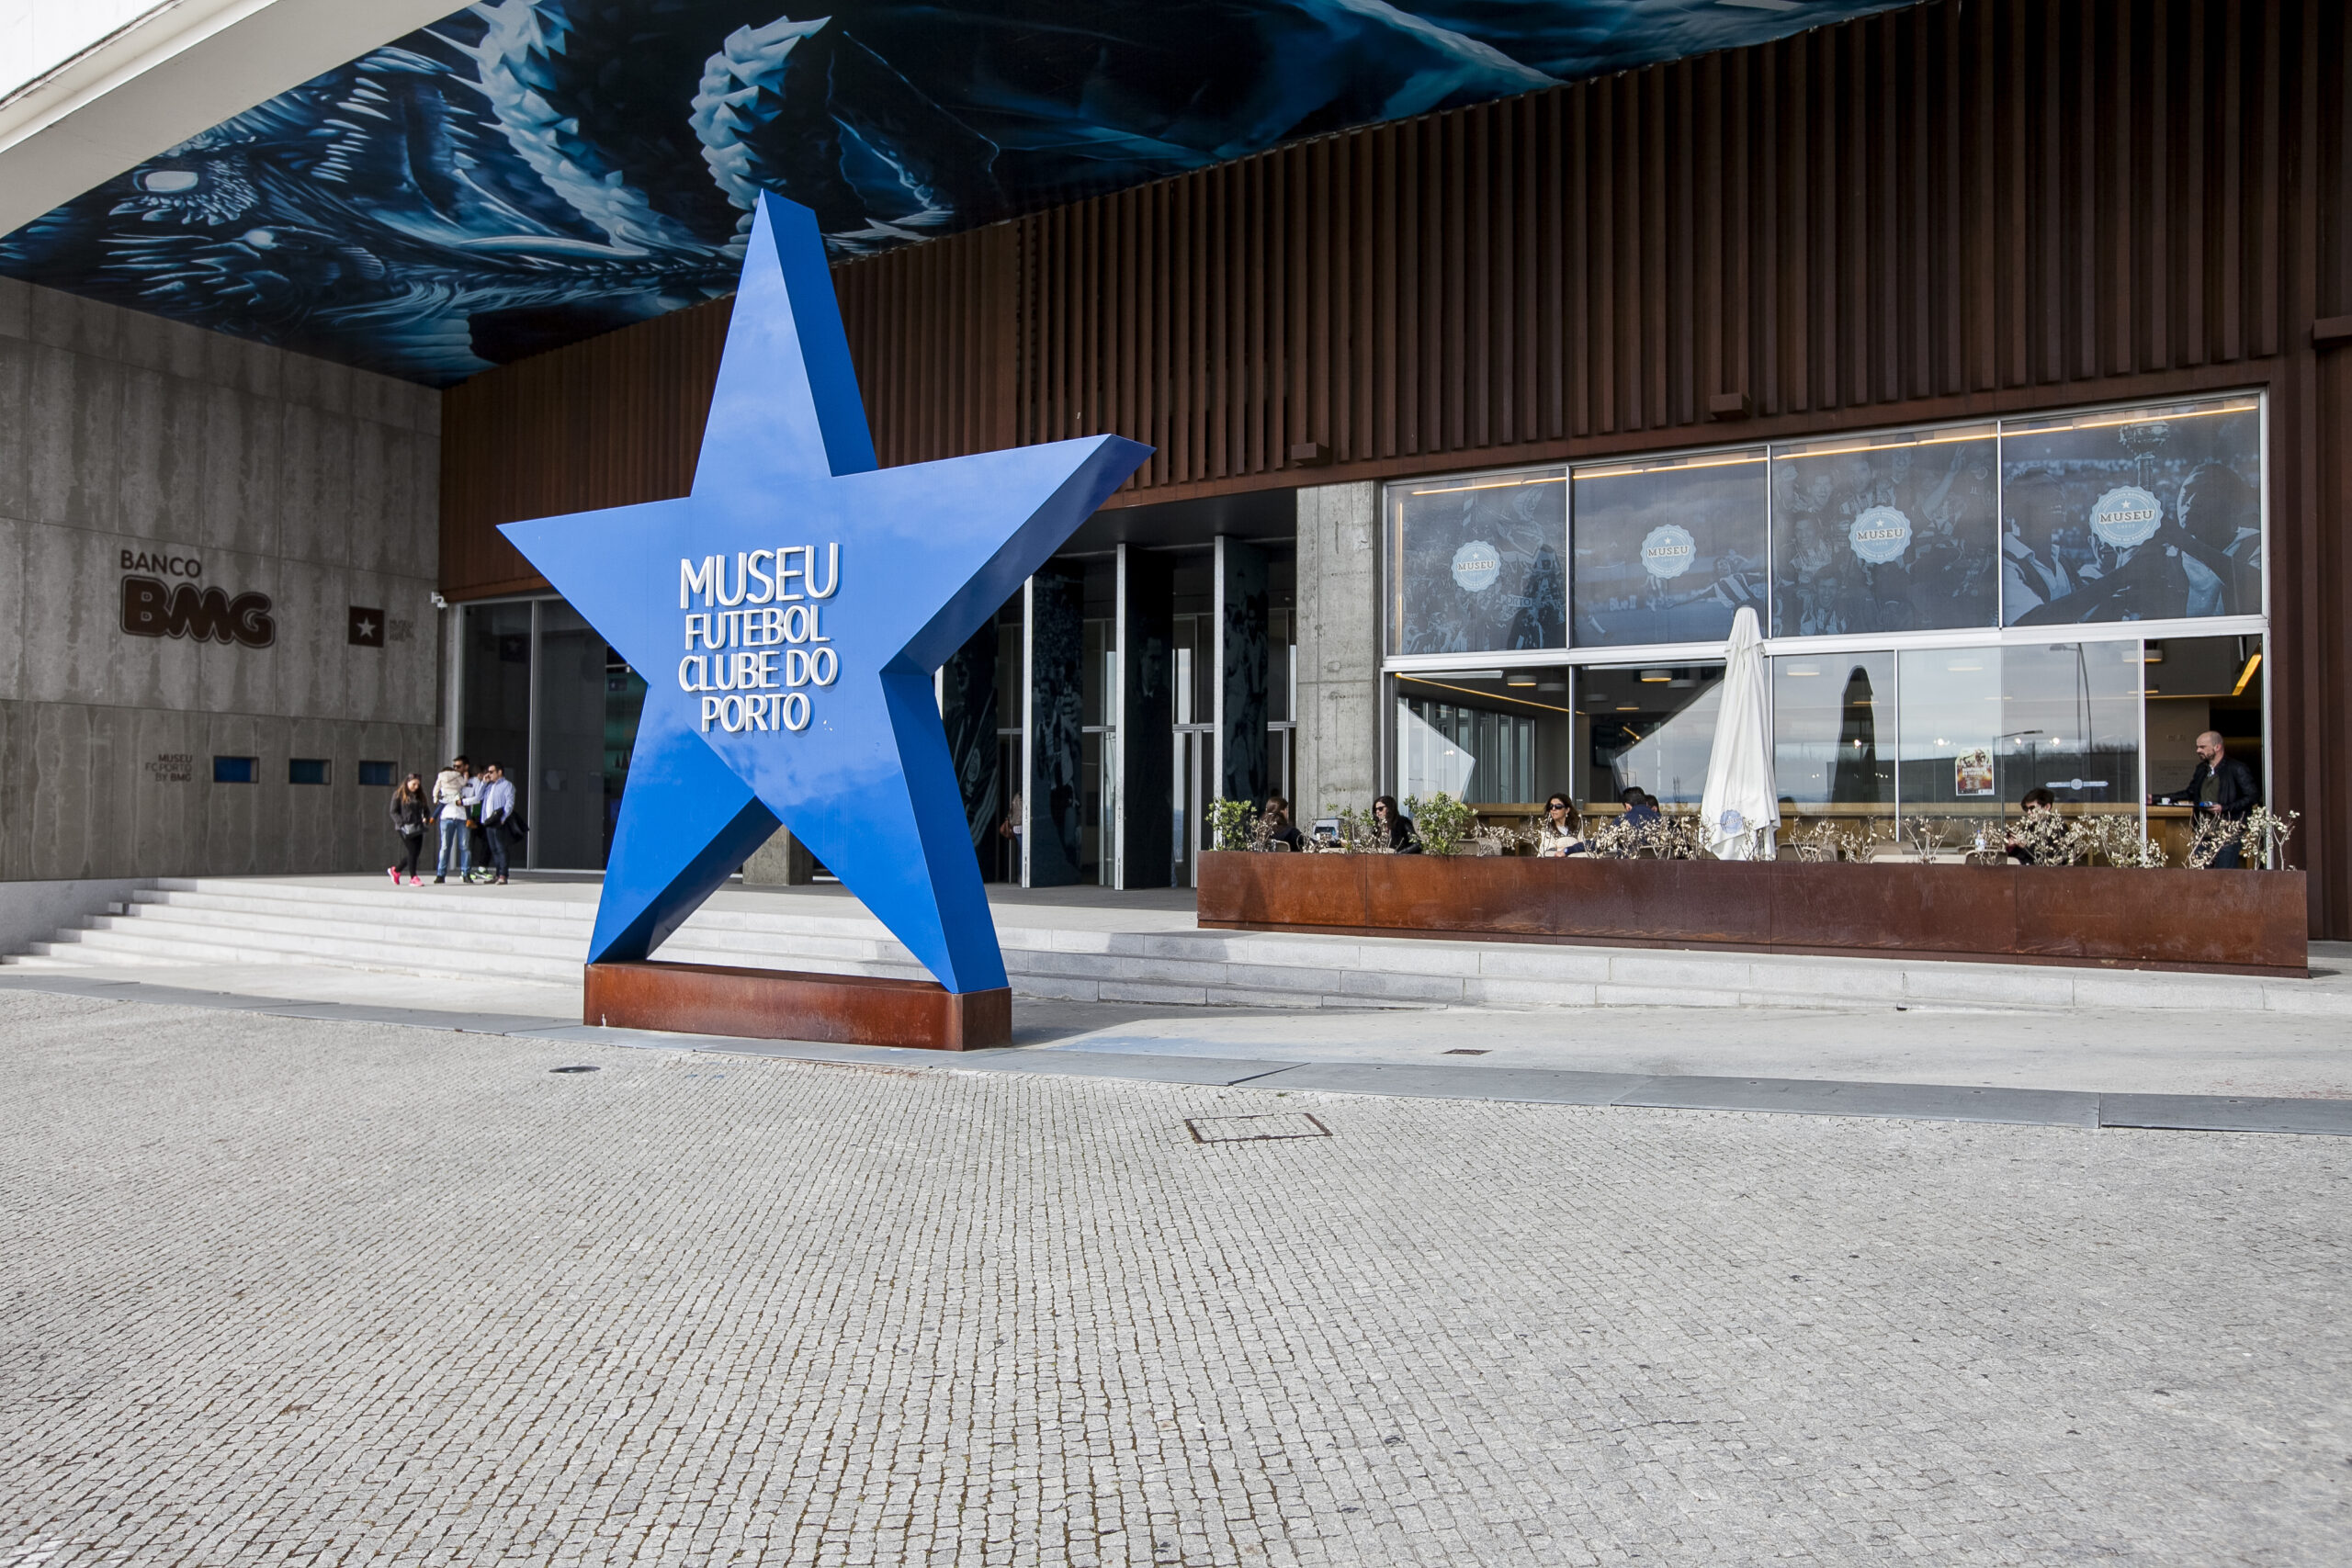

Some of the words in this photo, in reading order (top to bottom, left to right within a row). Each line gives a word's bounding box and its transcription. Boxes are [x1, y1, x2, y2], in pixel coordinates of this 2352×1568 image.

[2099, 510, 2154, 523] MUSEU
[1857, 528, 1904, 540] MUSEU
[1647, 546, 1689, 557] MUSEU
[120, 549, 202, 578] BANCO
[1457, 560, 1495, 570] MUSEU
[680, 542, 840, 609] MUSEU
[119, 574, 276, 649] BMG
[684, 604, 831, 650] FUTEBOL
[678, 650, 781, 693] CLUBE
[786, 647, 839, 687] DO
[701, 692, 811, 733] PORTO
[158, 753, 193, 762] MUSEU
[145, 762, 157, 772] FC
[159, 762, 192, 773] PORTO
[155, 773, 168, 782] BY
[170, 773, 192, 782] BMG
